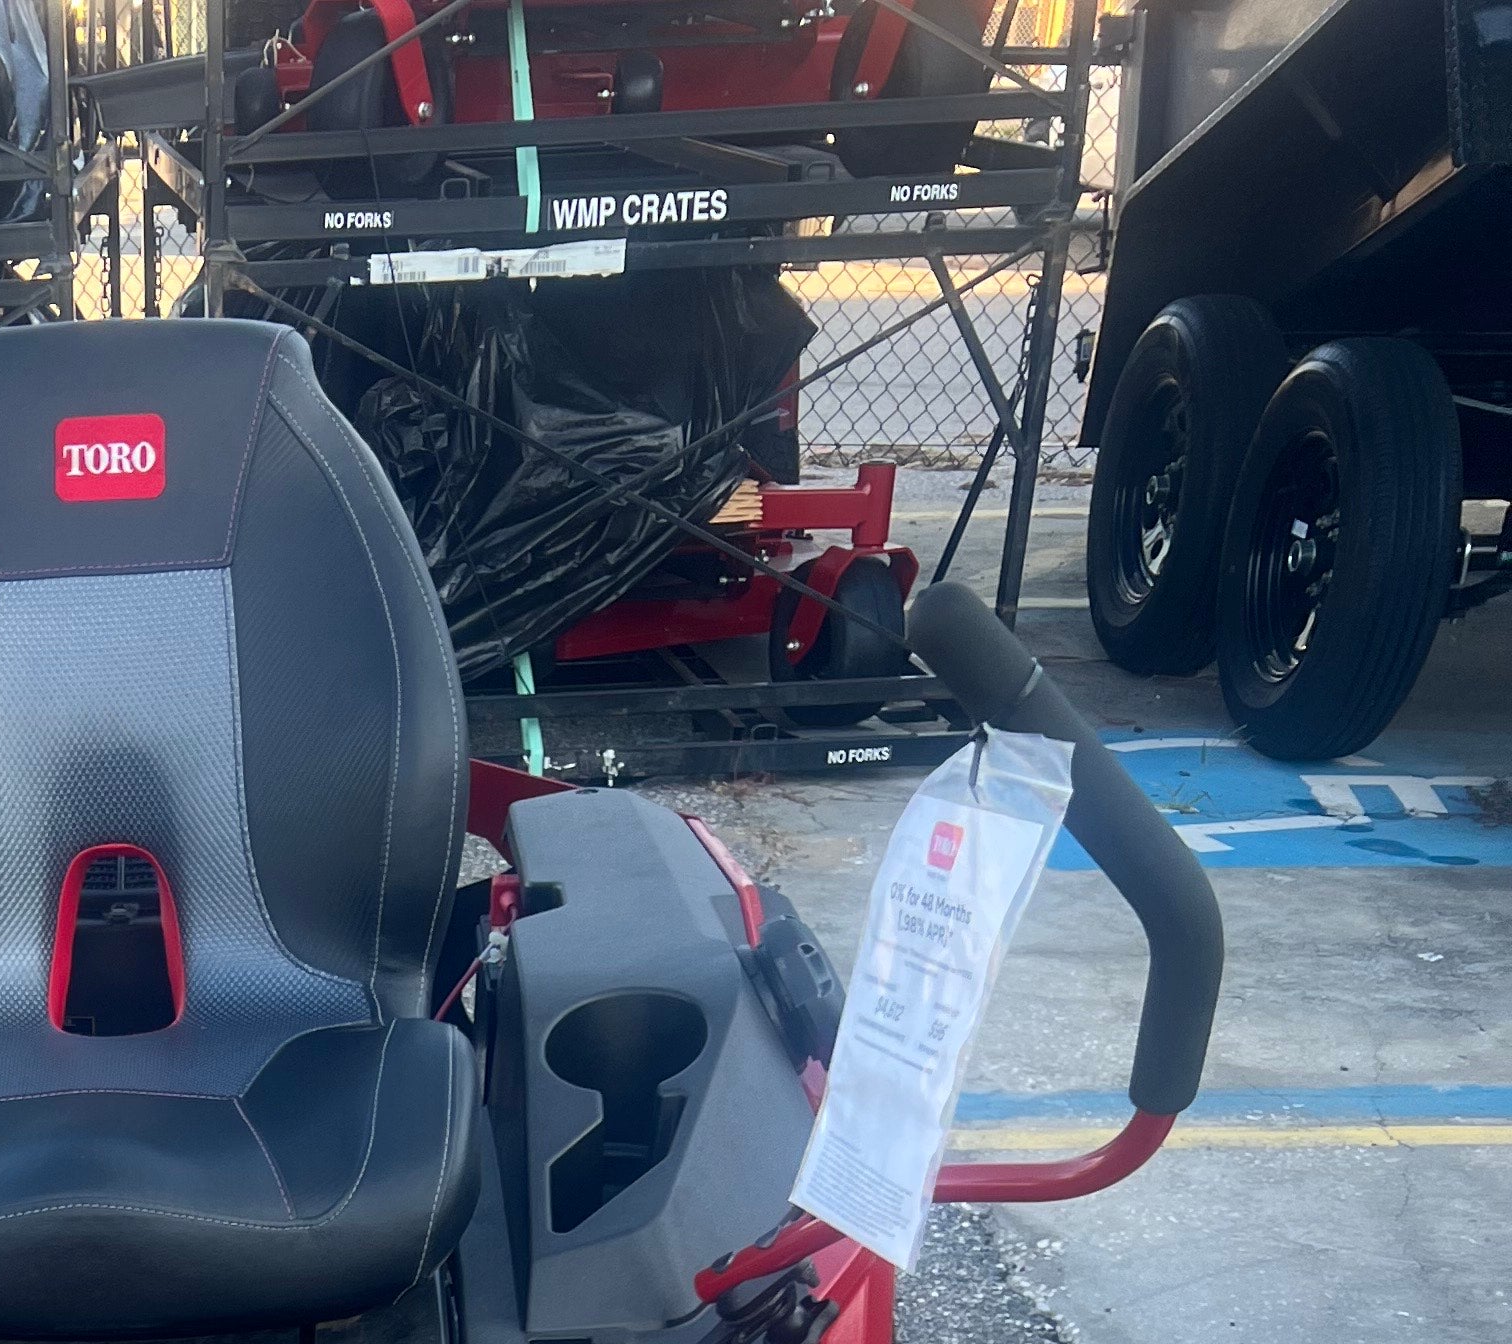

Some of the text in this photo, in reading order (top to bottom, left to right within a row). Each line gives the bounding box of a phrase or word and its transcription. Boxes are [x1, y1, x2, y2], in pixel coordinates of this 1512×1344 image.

[890, 183, 959, 202] NO FORKS
[324, 211, 392, 229] NO FORKS
[553, 189, 728, 230] WMP CRATES
[62, 440, 157, 477] TORO
[827, 746, 890, 764] NO FORKS
[890, 881, 907, 903] 0%
[906, 886, 921, 907] for
[934, 895, 973, 925] Months
